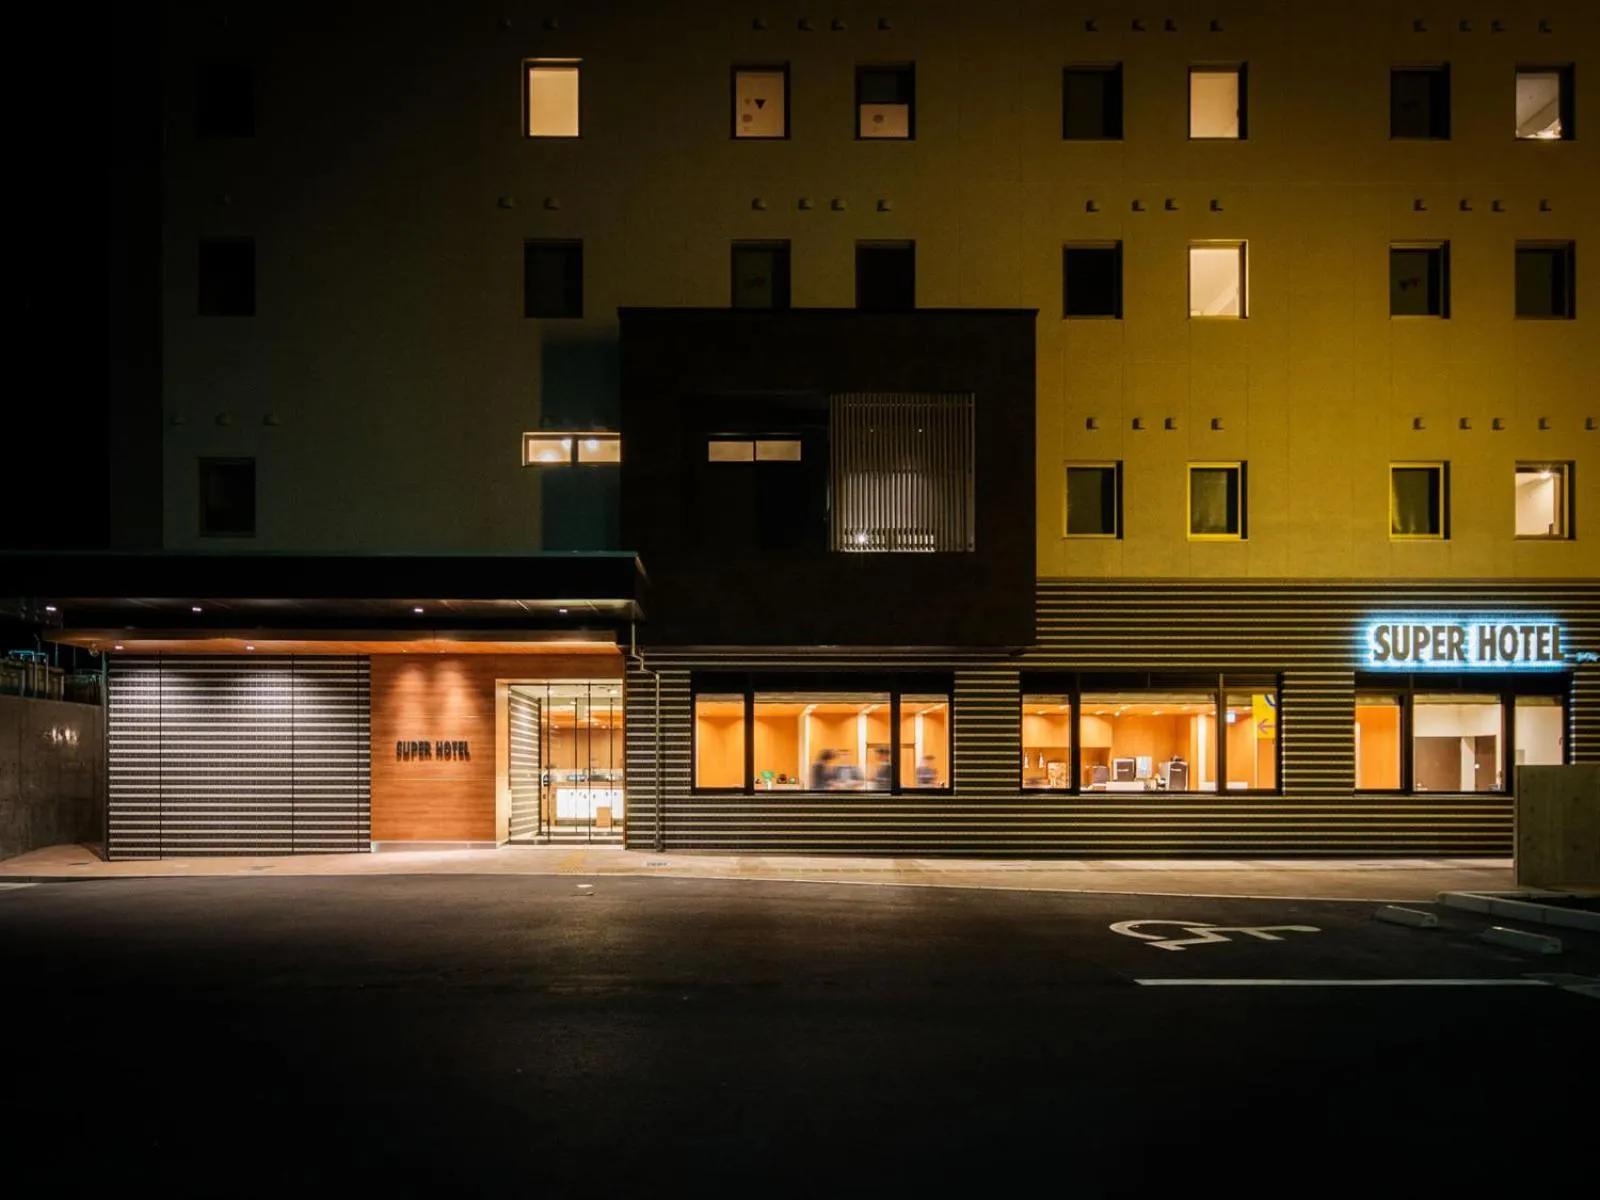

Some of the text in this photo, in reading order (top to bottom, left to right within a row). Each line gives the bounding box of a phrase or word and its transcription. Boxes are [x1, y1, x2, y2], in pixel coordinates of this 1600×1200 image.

[1373, 625, 1565, 661] SUPER HOTEL
[396, 740, 471, 761] SUPER HOTEL
